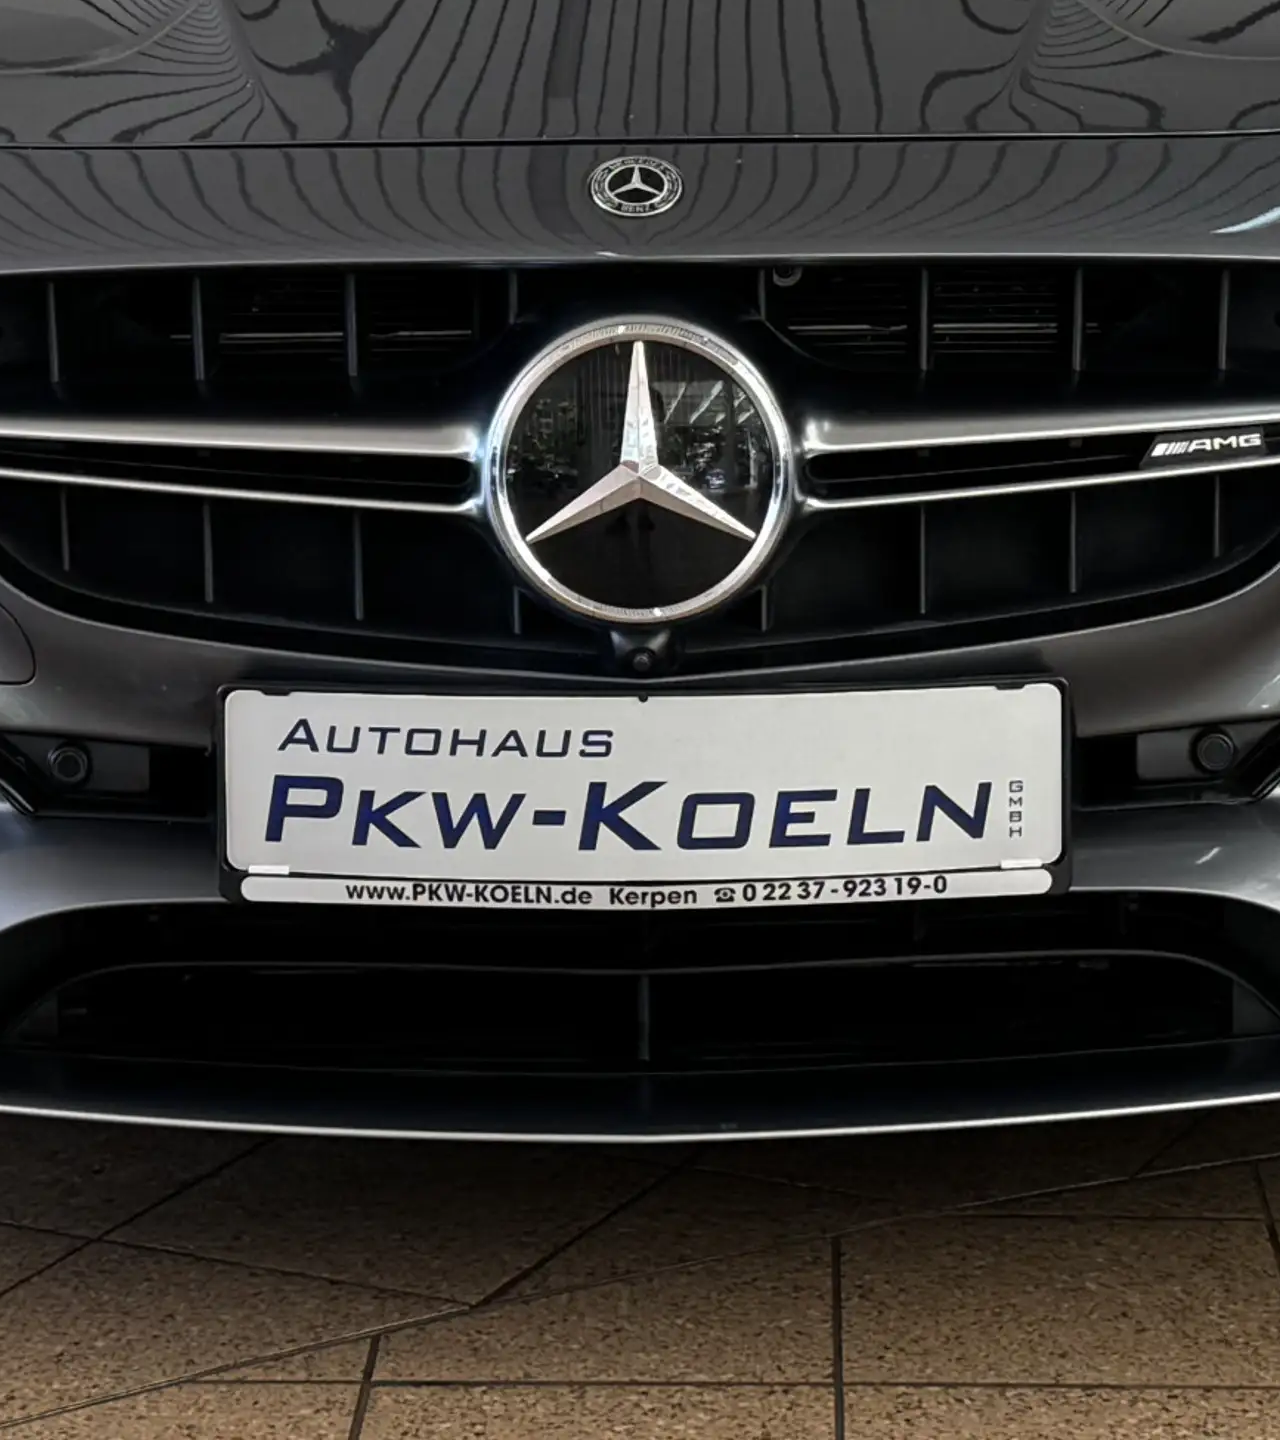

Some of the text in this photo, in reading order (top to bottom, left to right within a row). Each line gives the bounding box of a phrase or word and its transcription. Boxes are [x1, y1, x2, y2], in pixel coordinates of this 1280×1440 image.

[1188, 433, 1261, 453] AMG
[277, 718, 614, 758] AUTOHAUS
[264, 774, 992, 851] PKW-KOELN
[345, 883, 594, 906] www.PKW-KOELN.de
[608, 886, 698, 909] Kerpen
